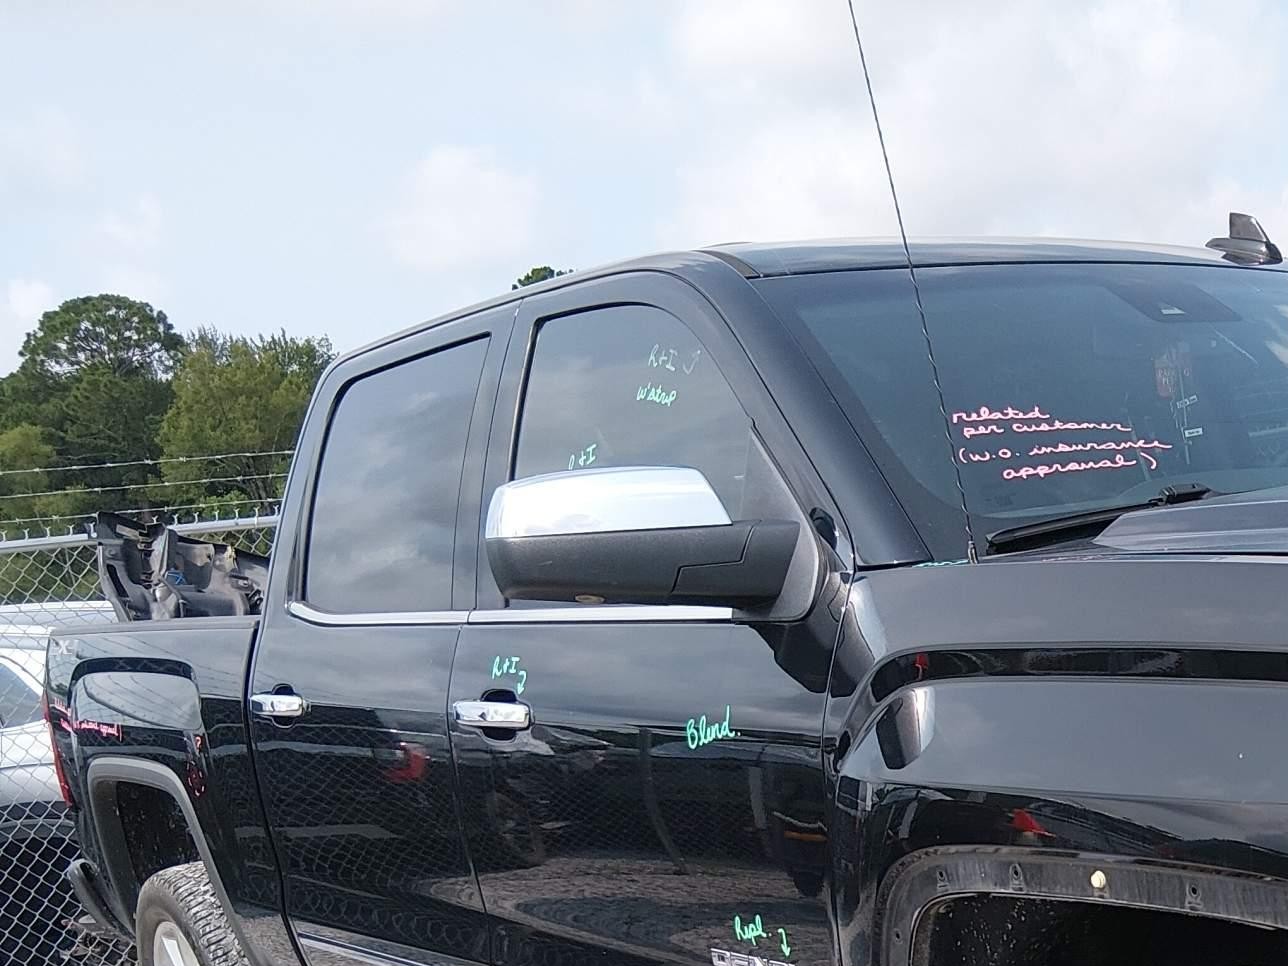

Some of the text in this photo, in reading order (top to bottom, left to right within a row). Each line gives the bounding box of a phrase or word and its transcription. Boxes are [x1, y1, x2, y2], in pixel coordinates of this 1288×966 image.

[963, 419, 1132, 439] per customer
[1028, 437, 1173, 456] insurance
